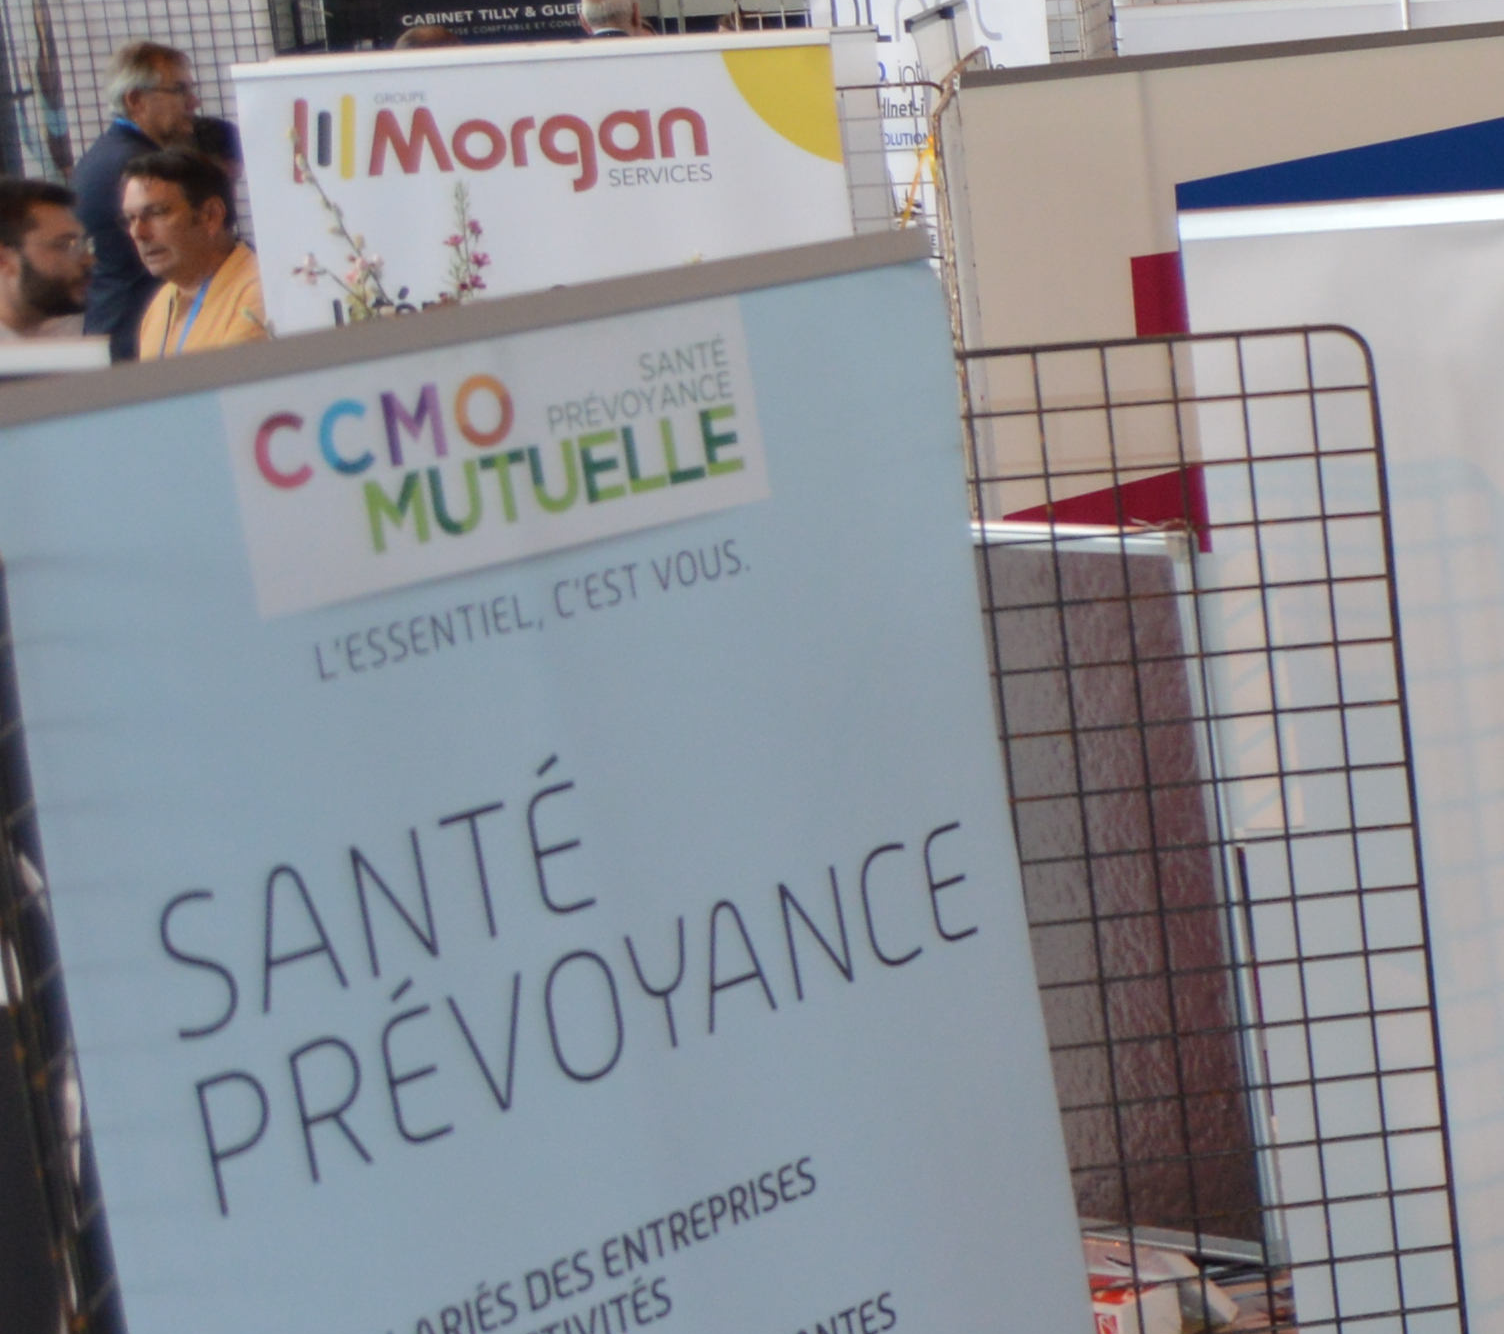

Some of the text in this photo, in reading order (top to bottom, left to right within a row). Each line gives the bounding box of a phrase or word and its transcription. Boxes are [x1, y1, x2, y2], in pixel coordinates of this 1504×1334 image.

[402, 11, 473, 27] CABINET
[477, 7, 519, 21] TILLY
[524, 5, 537, 18] &
[374, 91, 427, 105] GROUPE
[368, 106, 710, 193] Morgan
[608, 163, 713, 187] SERVICES
[548, 370, 733, 435] PRÉVOYANCE
[639, 338, 728, 382] SANTÉ
[254, 374, 514, 490] CCMO
[363, 404, 746, 554] MUTUELLE
[313, 539, 750, 682] L'ESSENTIEL, C'EST VOUS.
[160, 754, 597, 1039] SANTÉ
[195, 821, 979, 1217] PRÉVOYANCE
[524, 1250, 595, 1313] DES
[600, 1156, 818, 1280] ENTREPRISES
